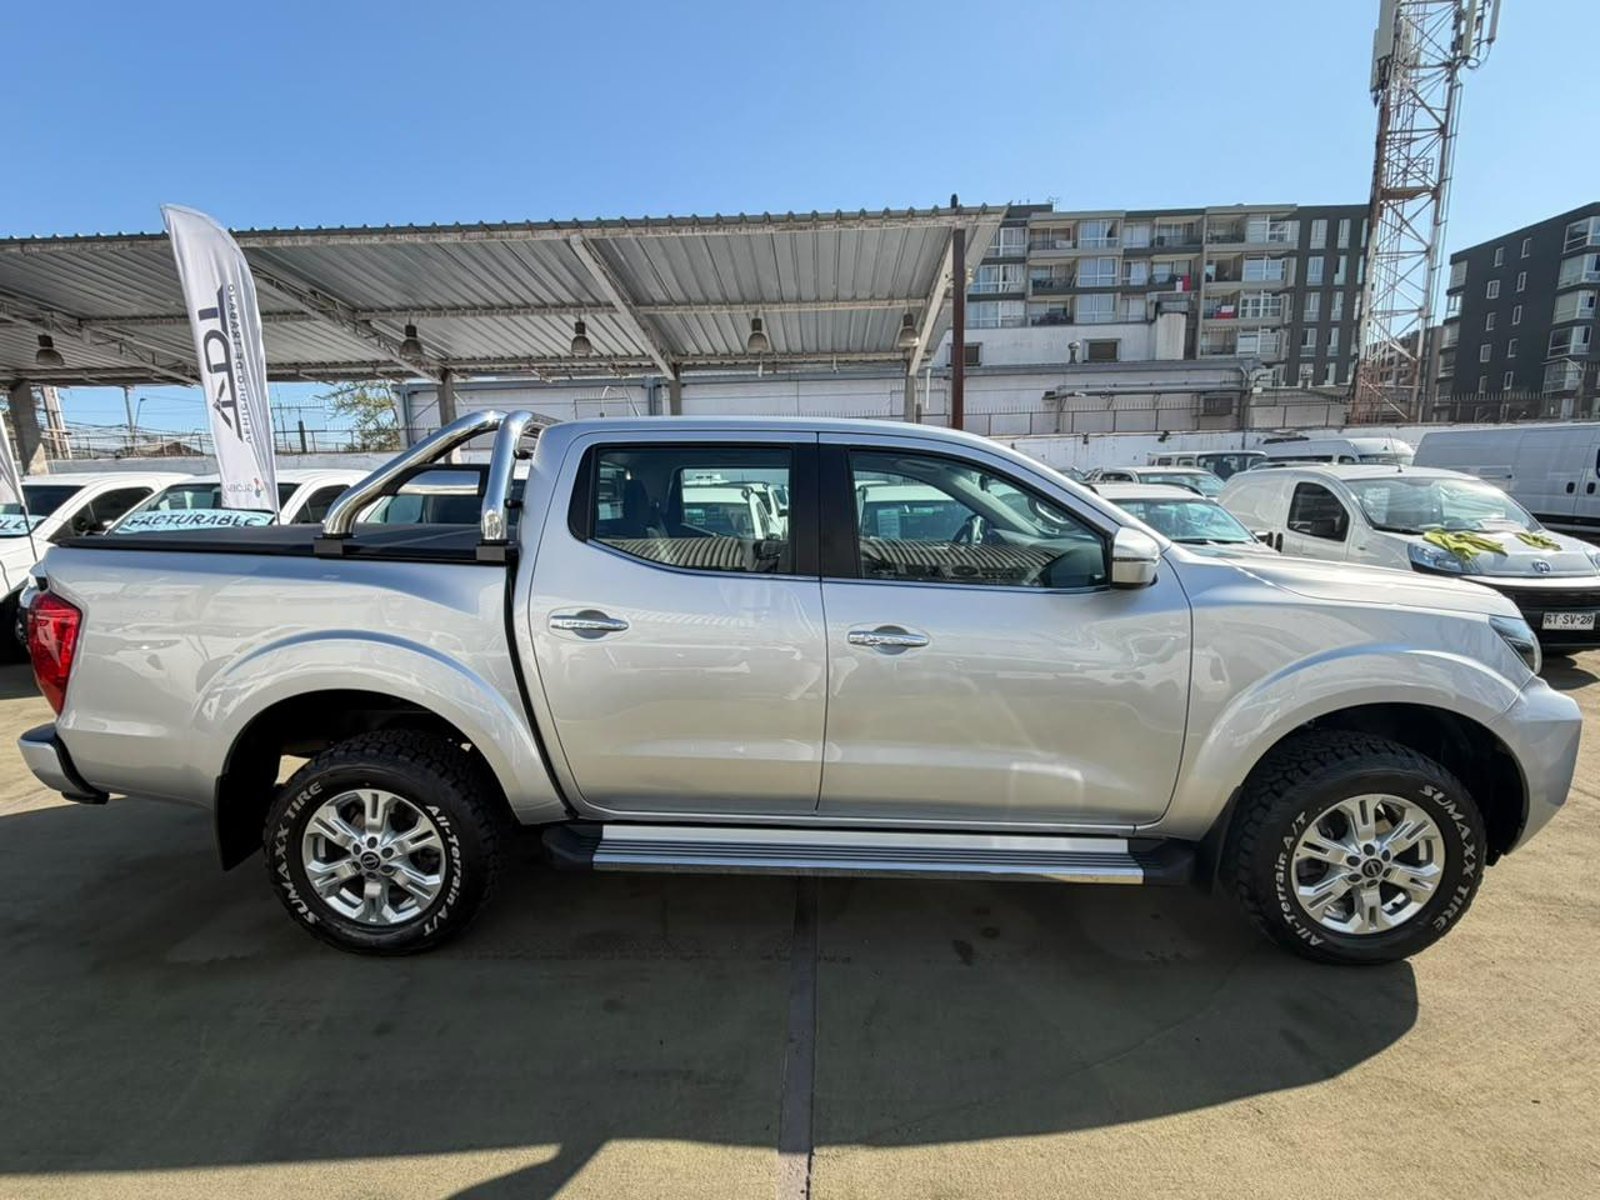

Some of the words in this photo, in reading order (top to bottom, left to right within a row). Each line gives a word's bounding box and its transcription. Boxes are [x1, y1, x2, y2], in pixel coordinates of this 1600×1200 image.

[129, 514, 261, 527] FACTURABLE
[284, 781, 323, 819] TIRE
[1283, 811, 1306, 849] A/T
[1419, 784, 1476, 878] SUMAXX
[275, 823, 320, 924] SUMAXX
[424, 904, 448, 936] A/T
[1433, 885, 1470, 931] TIRE
